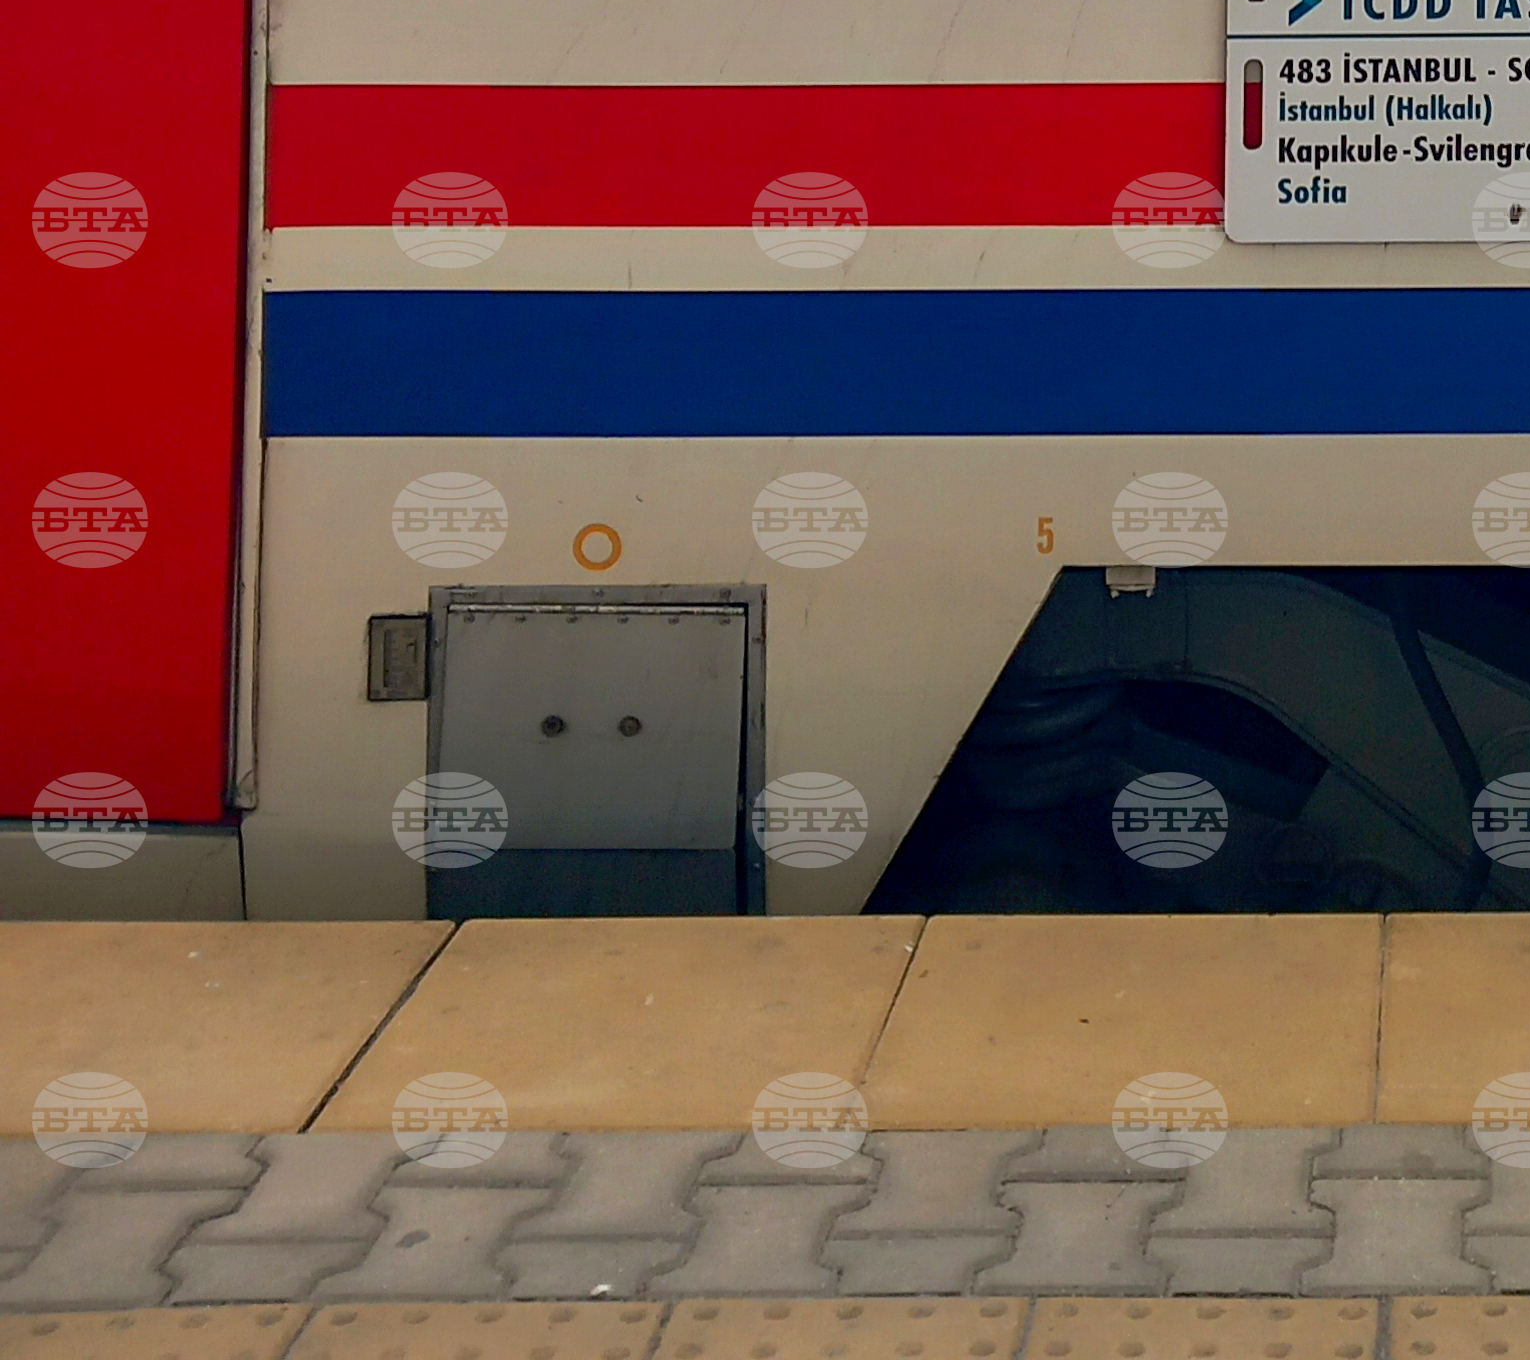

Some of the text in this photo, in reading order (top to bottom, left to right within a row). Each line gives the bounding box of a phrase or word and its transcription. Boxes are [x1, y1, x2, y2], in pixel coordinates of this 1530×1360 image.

[1279, 59, 1332, 84] 483
[1343, 52, 1476, 84] İSTANBUL
[1279, 92, 1493, 126] İstanbul (Halkalı)
[1278, 178, 1348, 205] Sofia
[1036, 516, 1055, 555] 5
